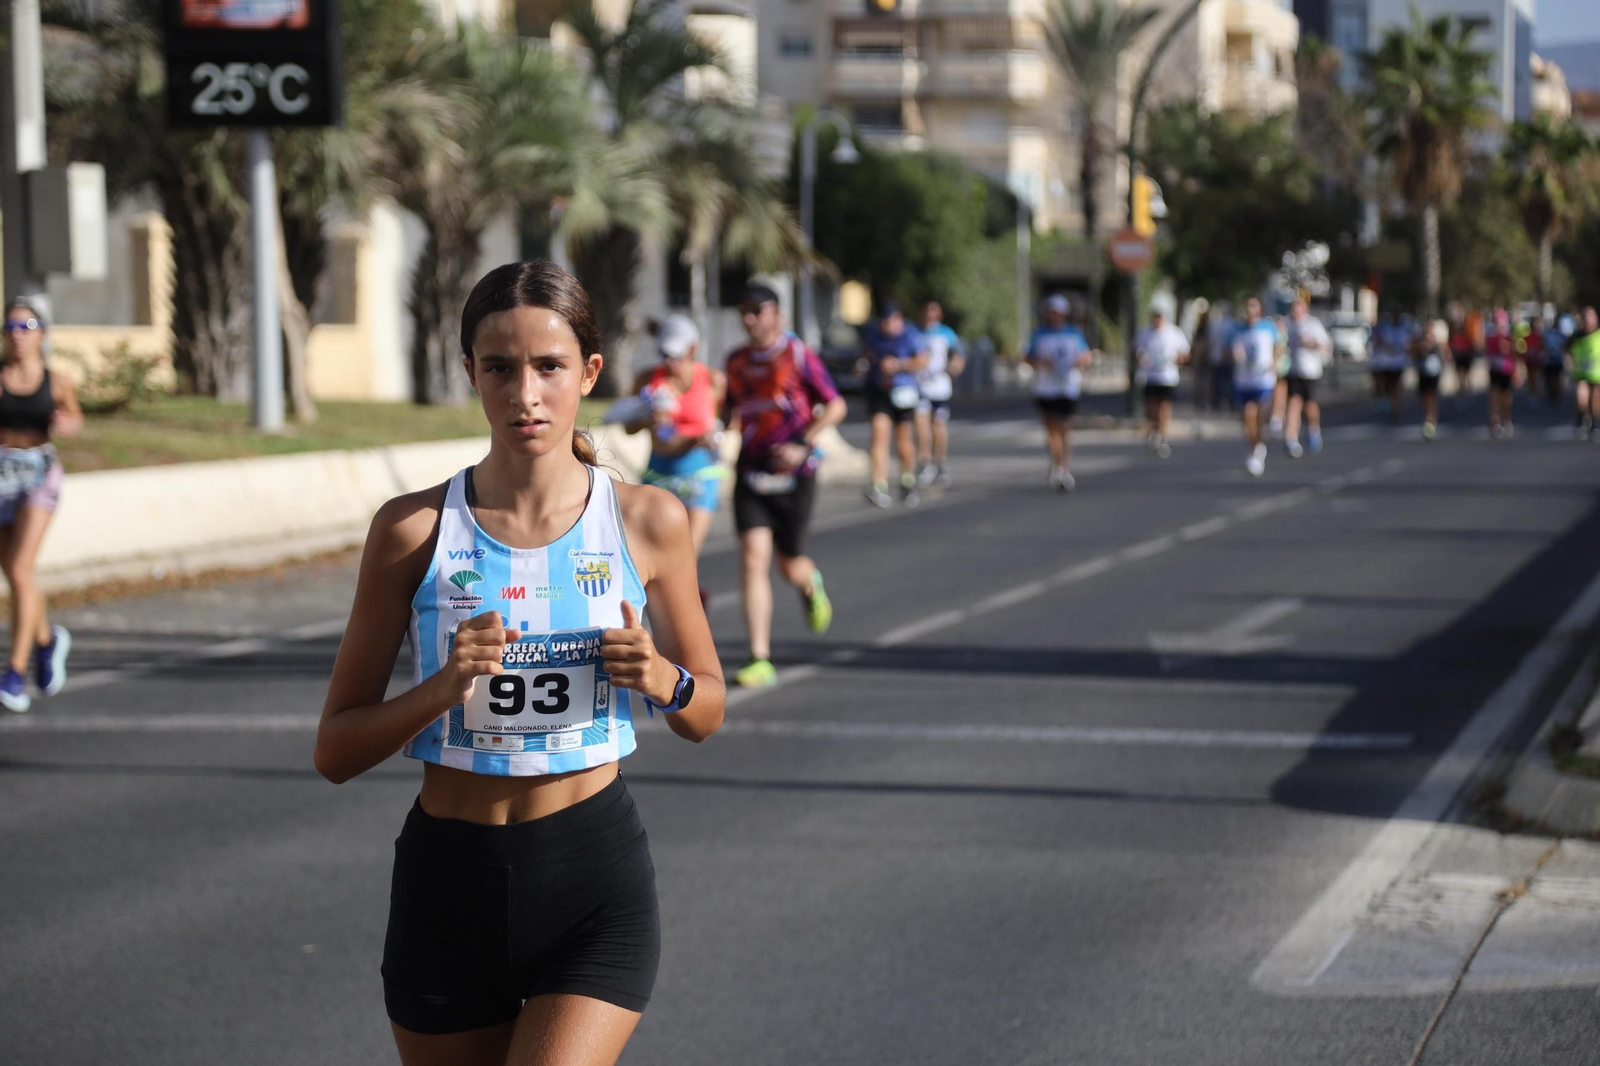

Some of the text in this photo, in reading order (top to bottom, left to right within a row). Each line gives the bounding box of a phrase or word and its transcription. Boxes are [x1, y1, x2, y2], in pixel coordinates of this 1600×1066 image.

[190, 61, 311, 116] 25°C
[447, 548, 486, 560] vive
[452, 603, 477, 611] Unicaja
[503, 637, 601, 654] RRERA URBANA
[566, 650, 580, 662] LA
[585, 647, 602, 660] PA
[488, 672, 570, 716] 93
[483, 723, 573, 732] CANO MALDONADO, ELENA
